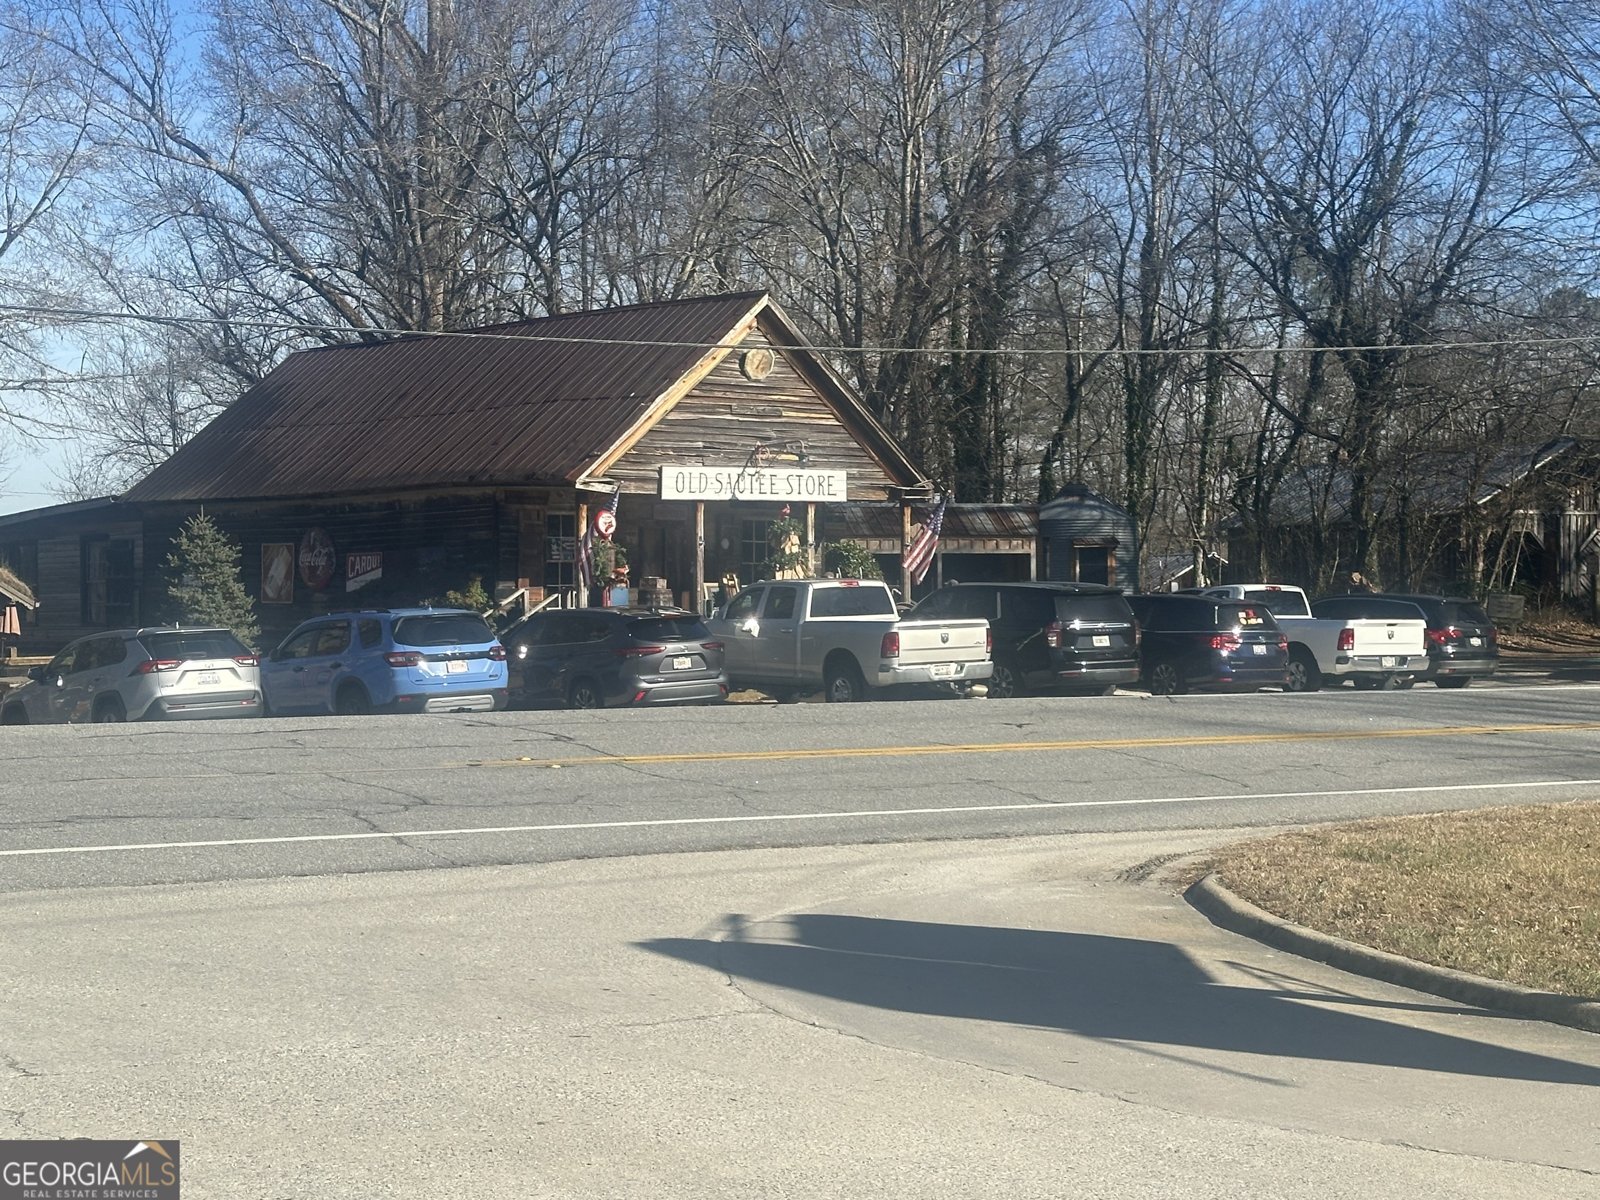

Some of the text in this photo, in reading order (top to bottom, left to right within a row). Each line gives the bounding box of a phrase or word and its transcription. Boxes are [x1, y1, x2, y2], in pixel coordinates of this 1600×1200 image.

[675, 471, 837, 497] OLD SAUTEE STORE
